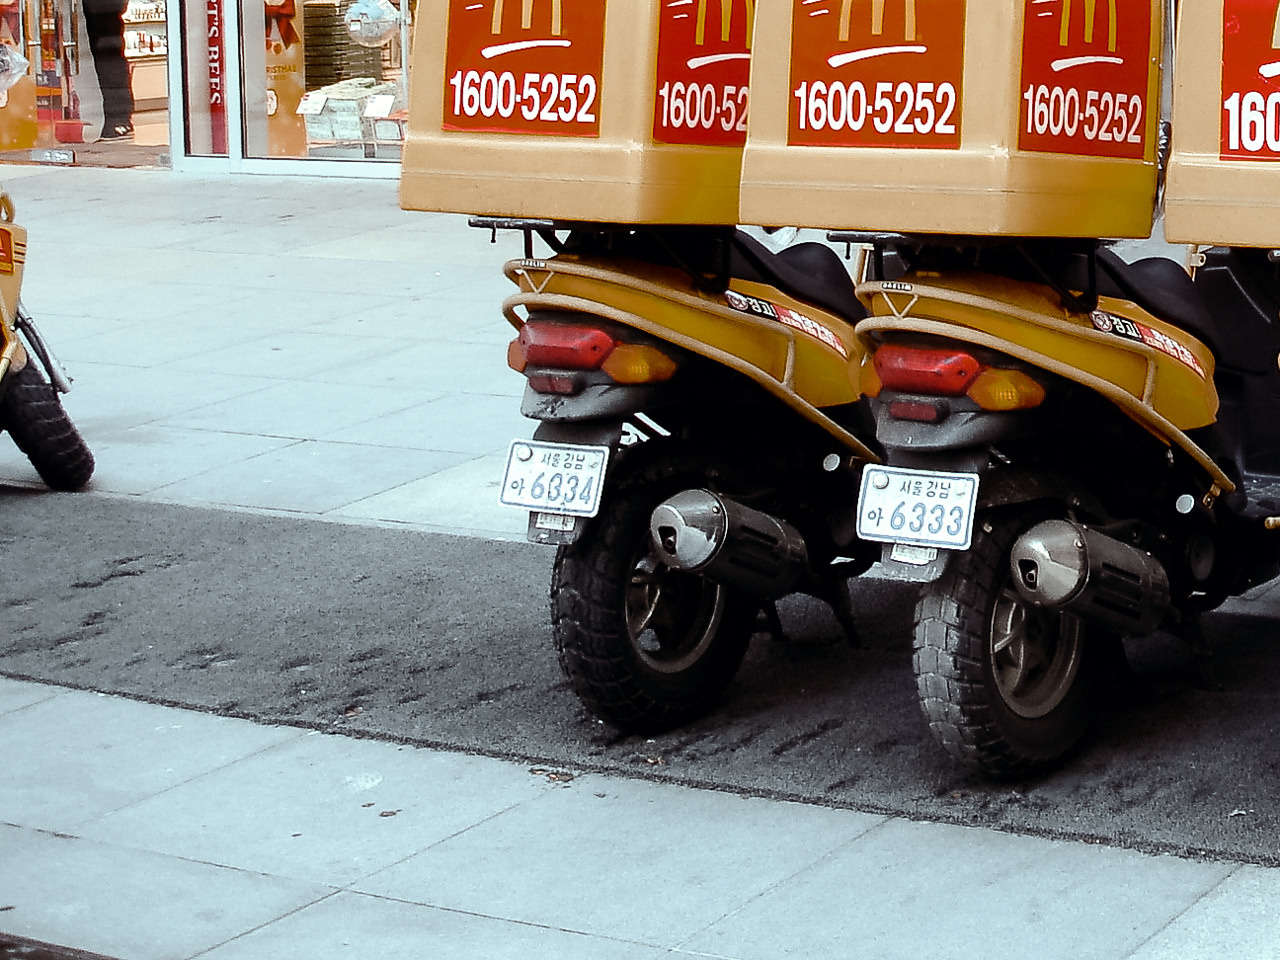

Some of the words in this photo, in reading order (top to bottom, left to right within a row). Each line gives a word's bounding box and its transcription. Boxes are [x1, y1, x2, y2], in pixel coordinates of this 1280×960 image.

[659, 82, 749, 131] 1600-52
[511, 478, 525, 496] 아
[531, 472, 594, 505] 6334
[868, 507, 884, 527] 아
[890, 501, 963, 536] 6333
